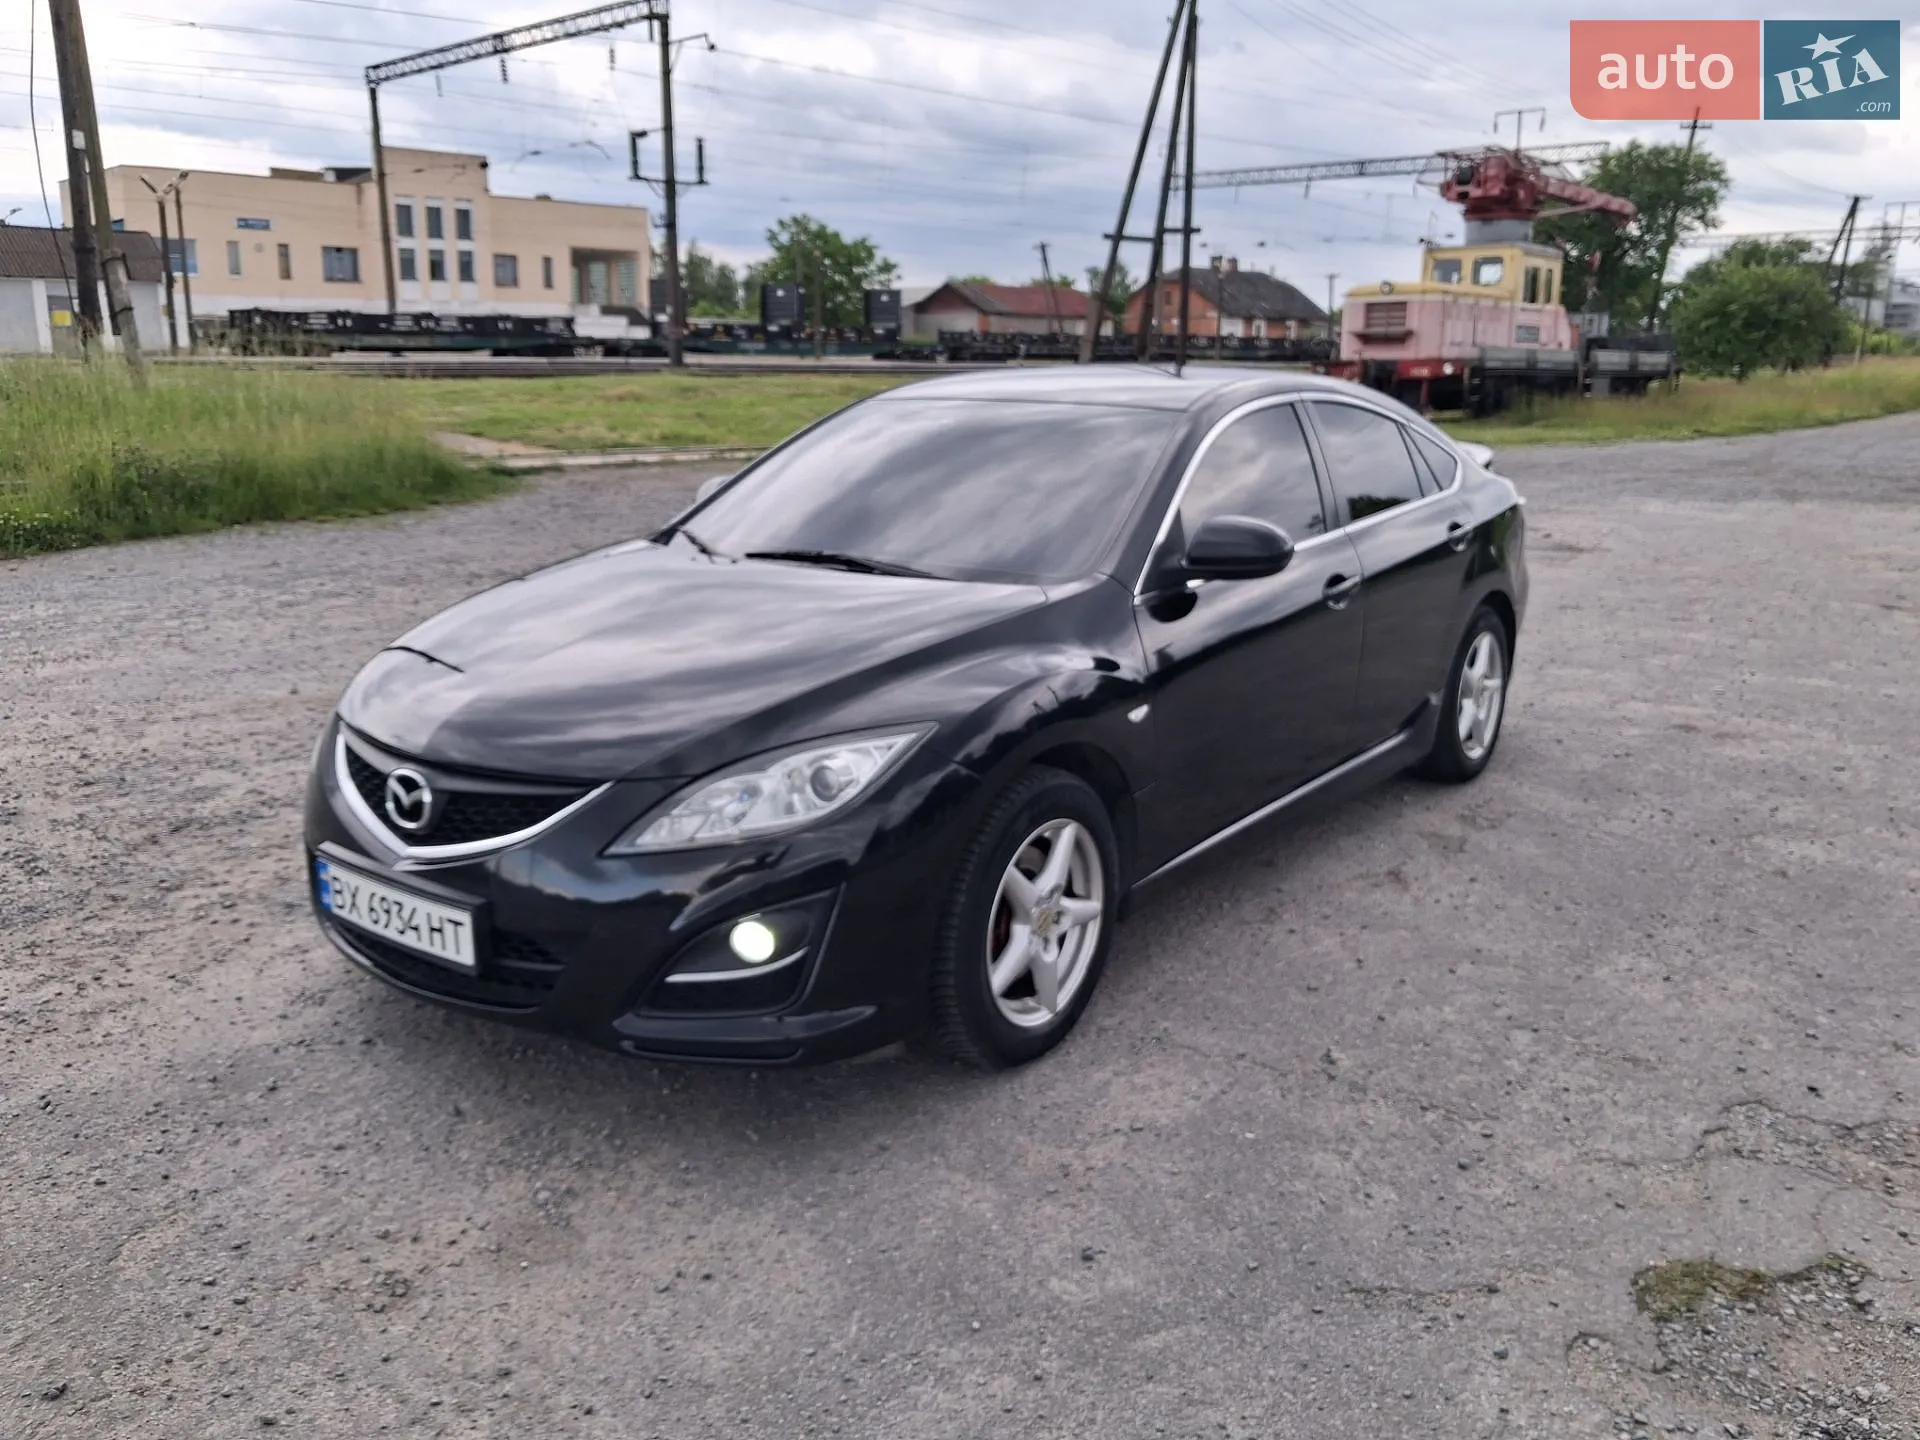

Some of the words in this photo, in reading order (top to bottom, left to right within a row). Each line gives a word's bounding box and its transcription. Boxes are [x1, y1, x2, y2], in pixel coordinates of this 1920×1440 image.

[331, 876, 363, 921] BX
[367, 891, 423, 943] 6934
[426, 911, 465, 956] HT
